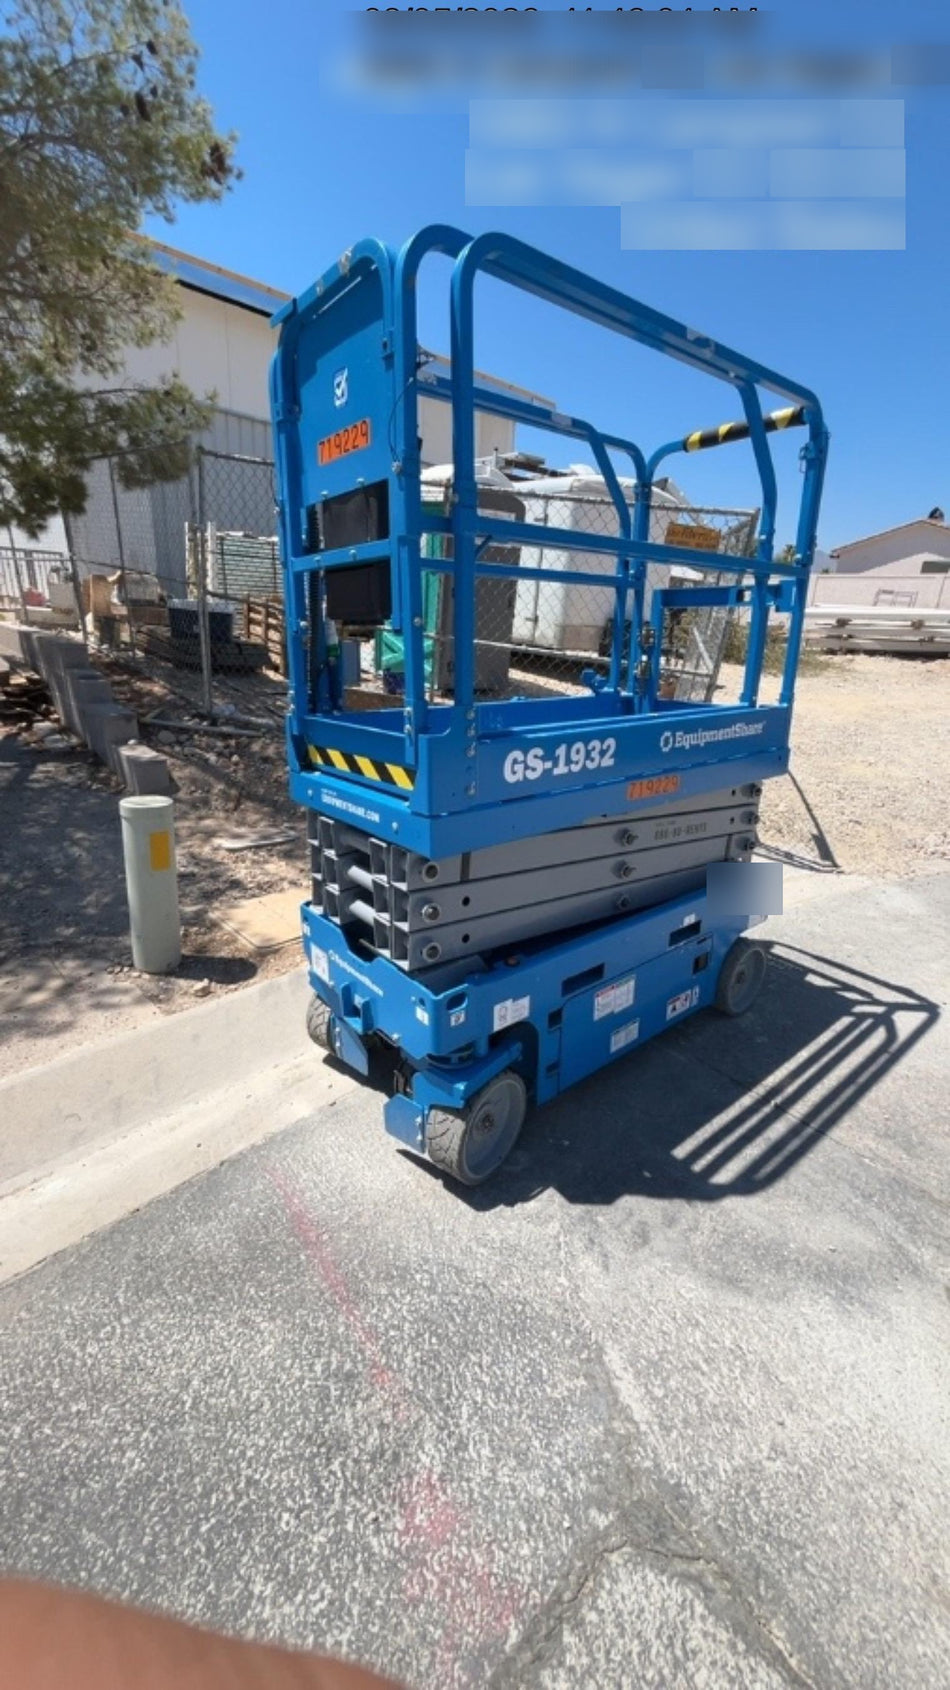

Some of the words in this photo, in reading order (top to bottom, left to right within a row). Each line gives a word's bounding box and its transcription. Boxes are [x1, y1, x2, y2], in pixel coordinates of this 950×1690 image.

[319, 419, 369, 463] 719229
[675, 722, 764, 749] EquipmentShare
[503, 738, 616, 783] GS-1932
[628, 775, 679, 799] 719229
